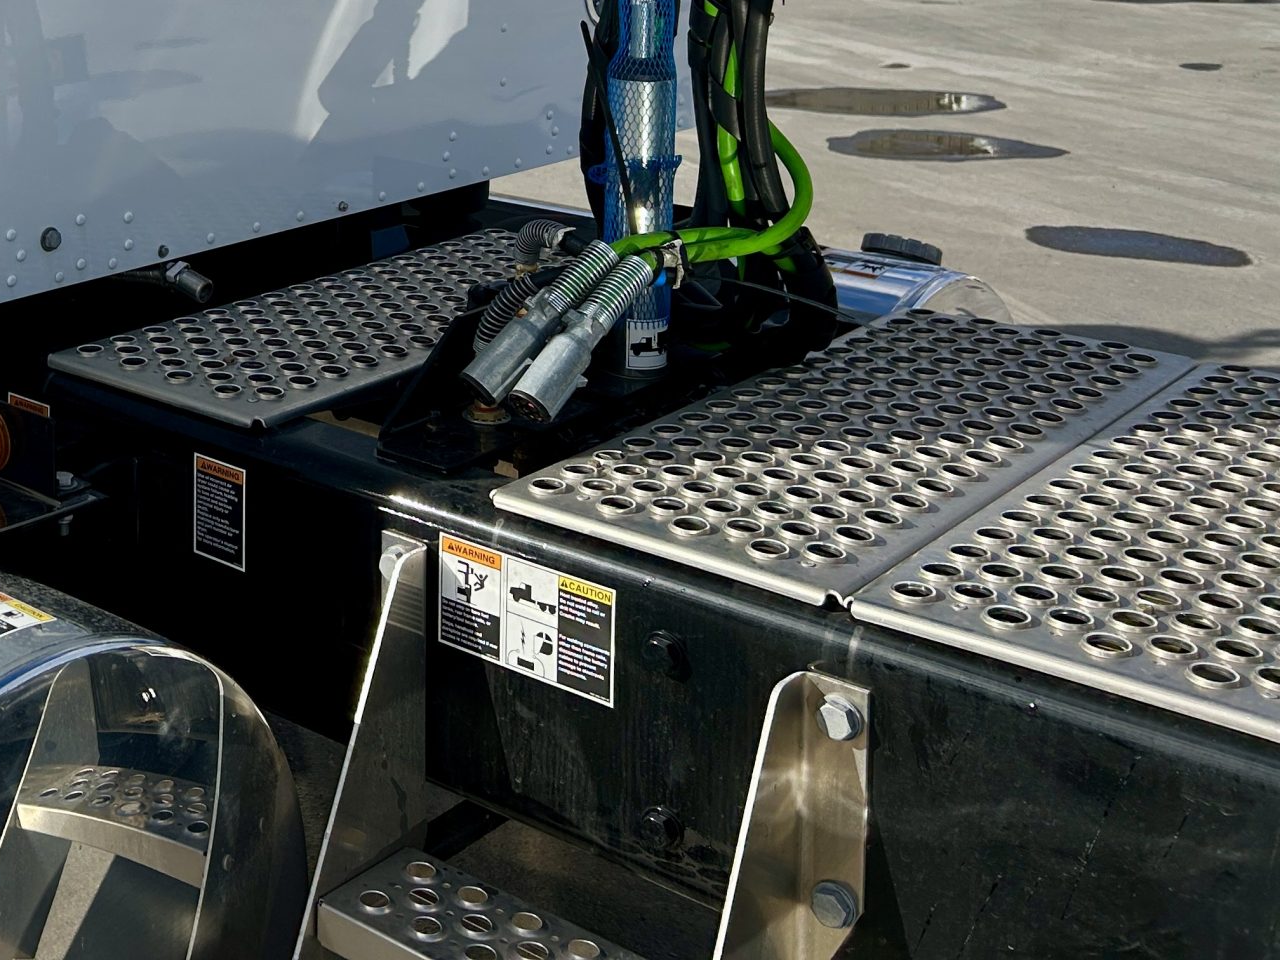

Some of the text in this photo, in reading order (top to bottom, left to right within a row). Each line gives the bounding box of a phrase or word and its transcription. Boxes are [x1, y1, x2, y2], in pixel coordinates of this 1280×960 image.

[205, 463, 240, 481] WARNING
[454, 543, 495, 565] WARNING
[569, 583, 611, 603] CAUTION
